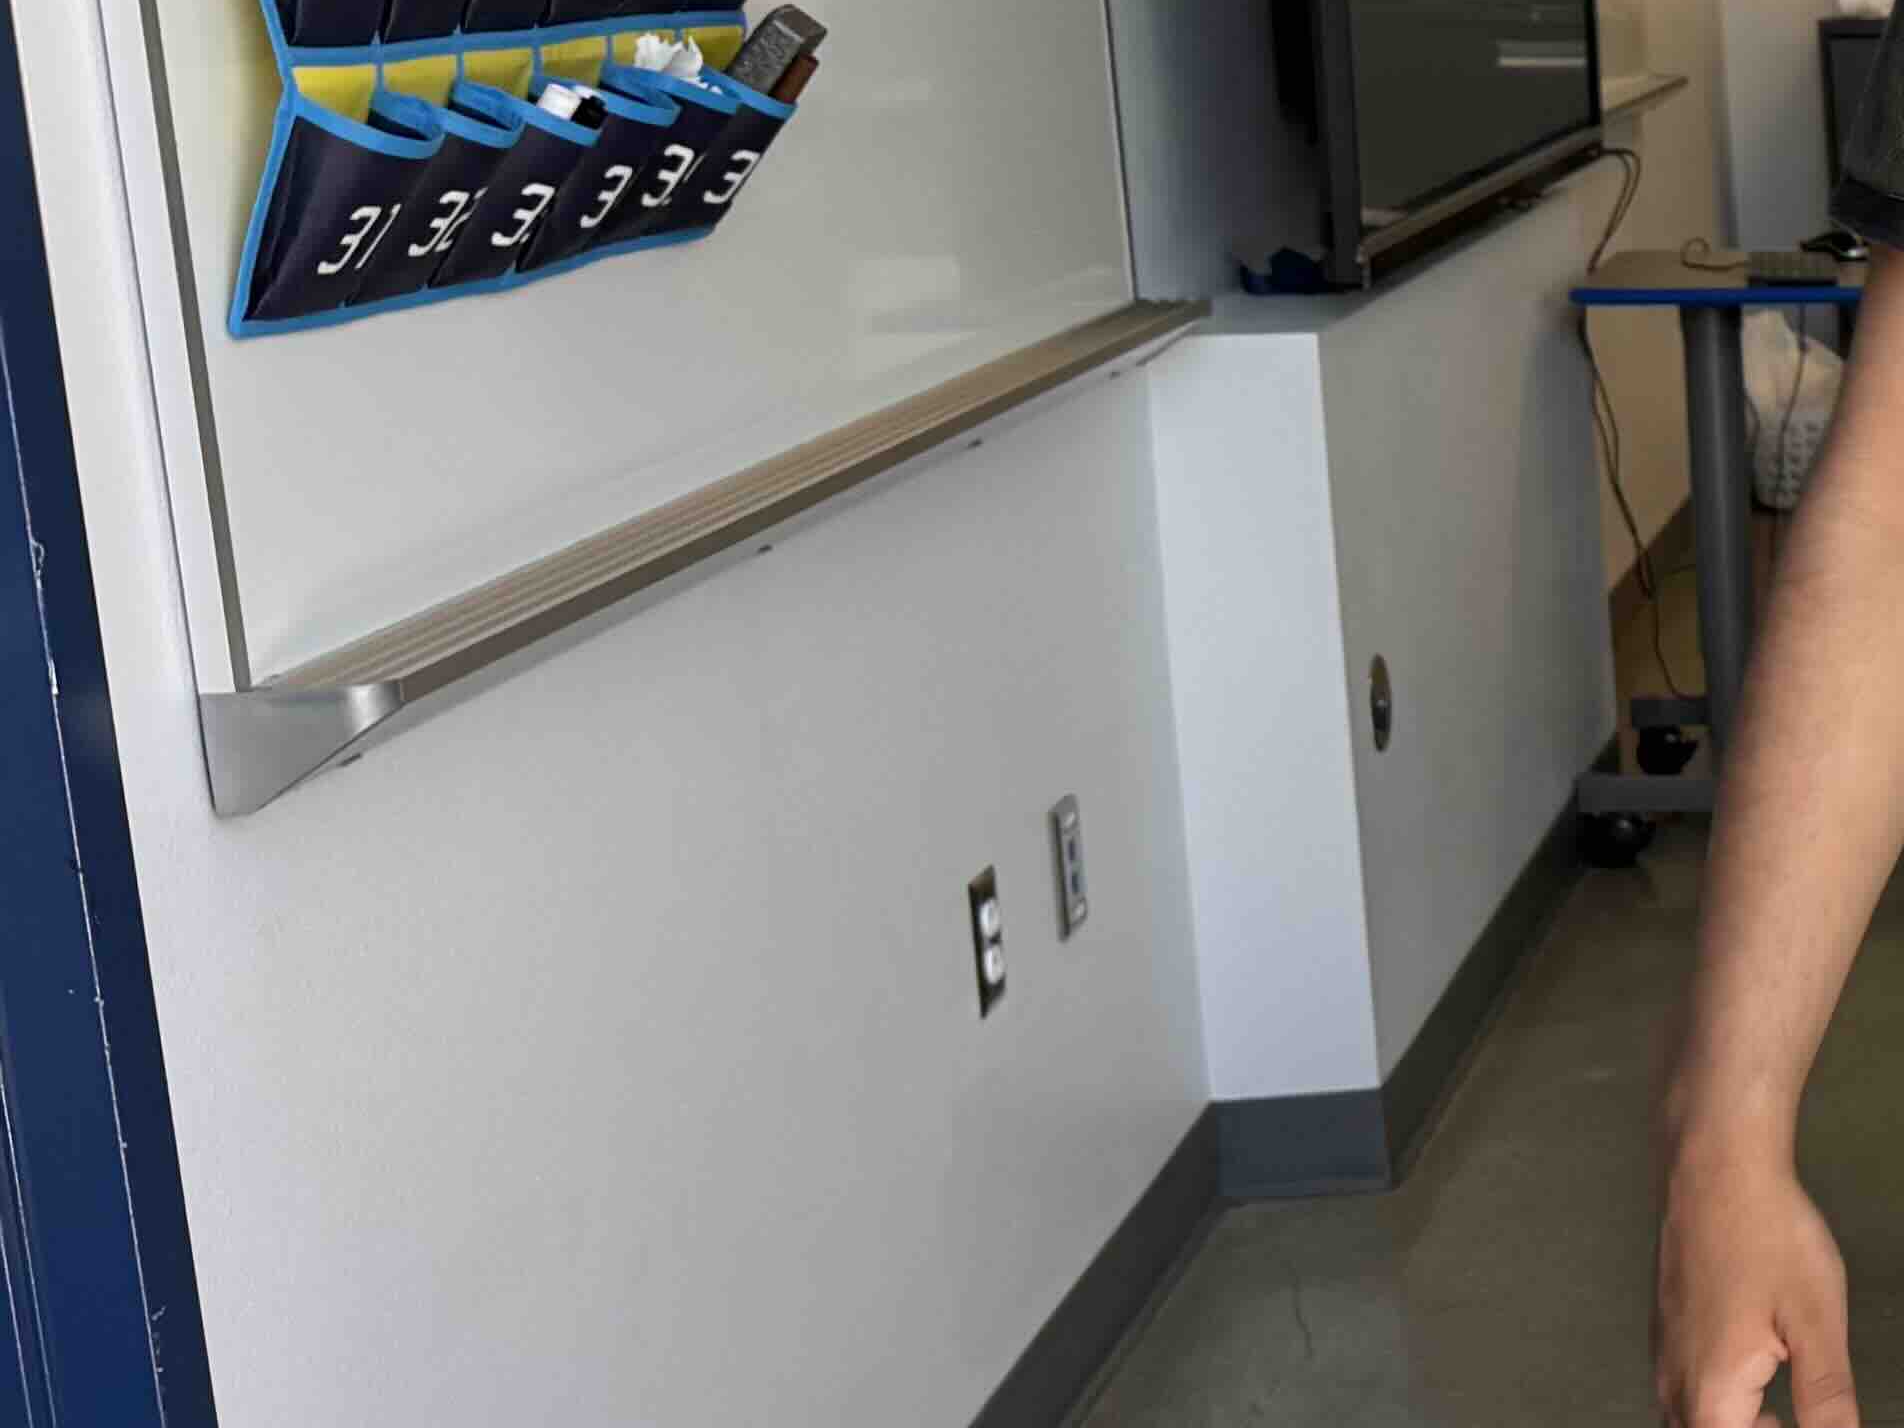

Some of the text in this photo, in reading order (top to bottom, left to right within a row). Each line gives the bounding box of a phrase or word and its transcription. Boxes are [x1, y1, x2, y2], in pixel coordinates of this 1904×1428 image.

[318, 204, 400, 274] 31
[492, 184, 554, 246] 3
[580, 165, 634, 229] 3
[641, 144, 706, 207] 3
[703, 150, 761, 204] 3
